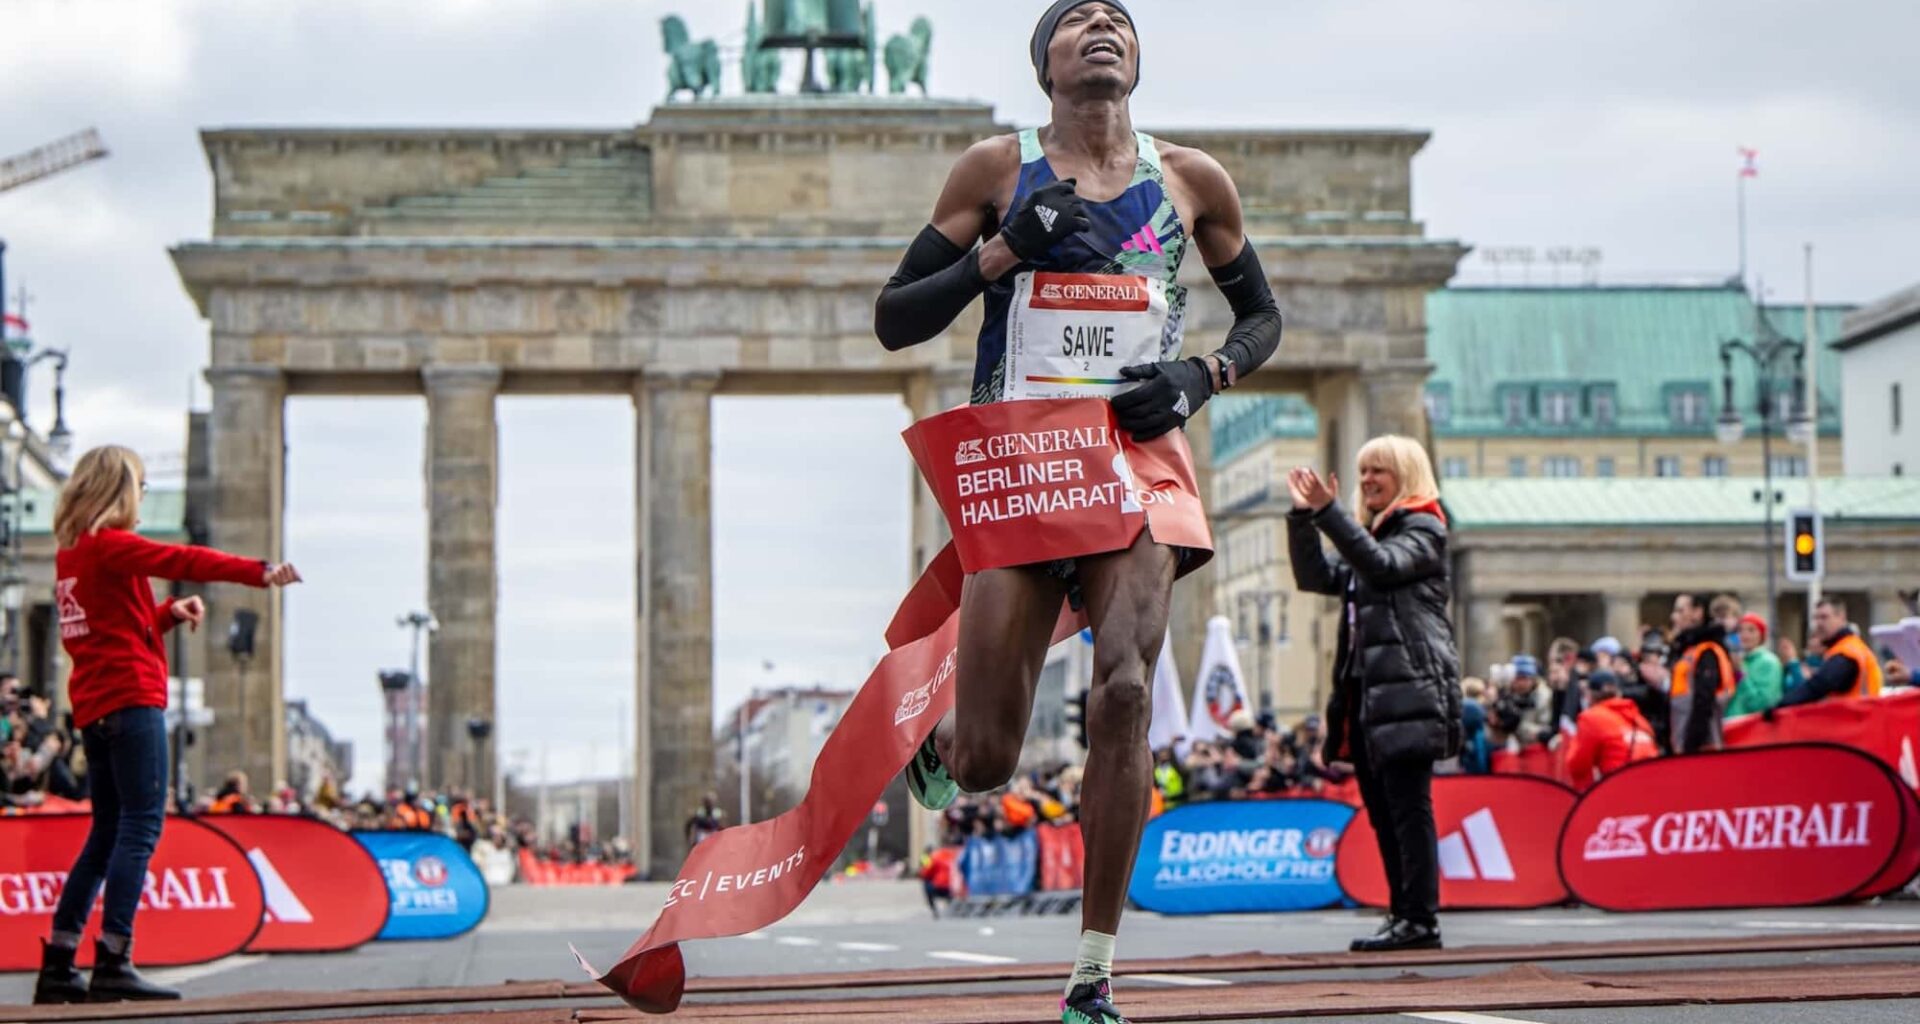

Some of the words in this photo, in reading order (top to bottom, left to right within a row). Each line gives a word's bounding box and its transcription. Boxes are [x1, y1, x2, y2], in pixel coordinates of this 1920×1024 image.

[1063, 284, 1139, 300] GENERALI
[1062, 325, 1115, 357] SAWE
[1083, 361, 1090, 371] 2
[987, 426, 1109, 459] GENERALI
[957, 458, 1084, 497] BERLINER
[960, 481, 1175, 527] HALBMARATHON
[1160, 828, 1304, 861] ERDINGER
[1651, 801, 1873, 855] GENERALI
[715, 845, 805, 892] EVENTS
